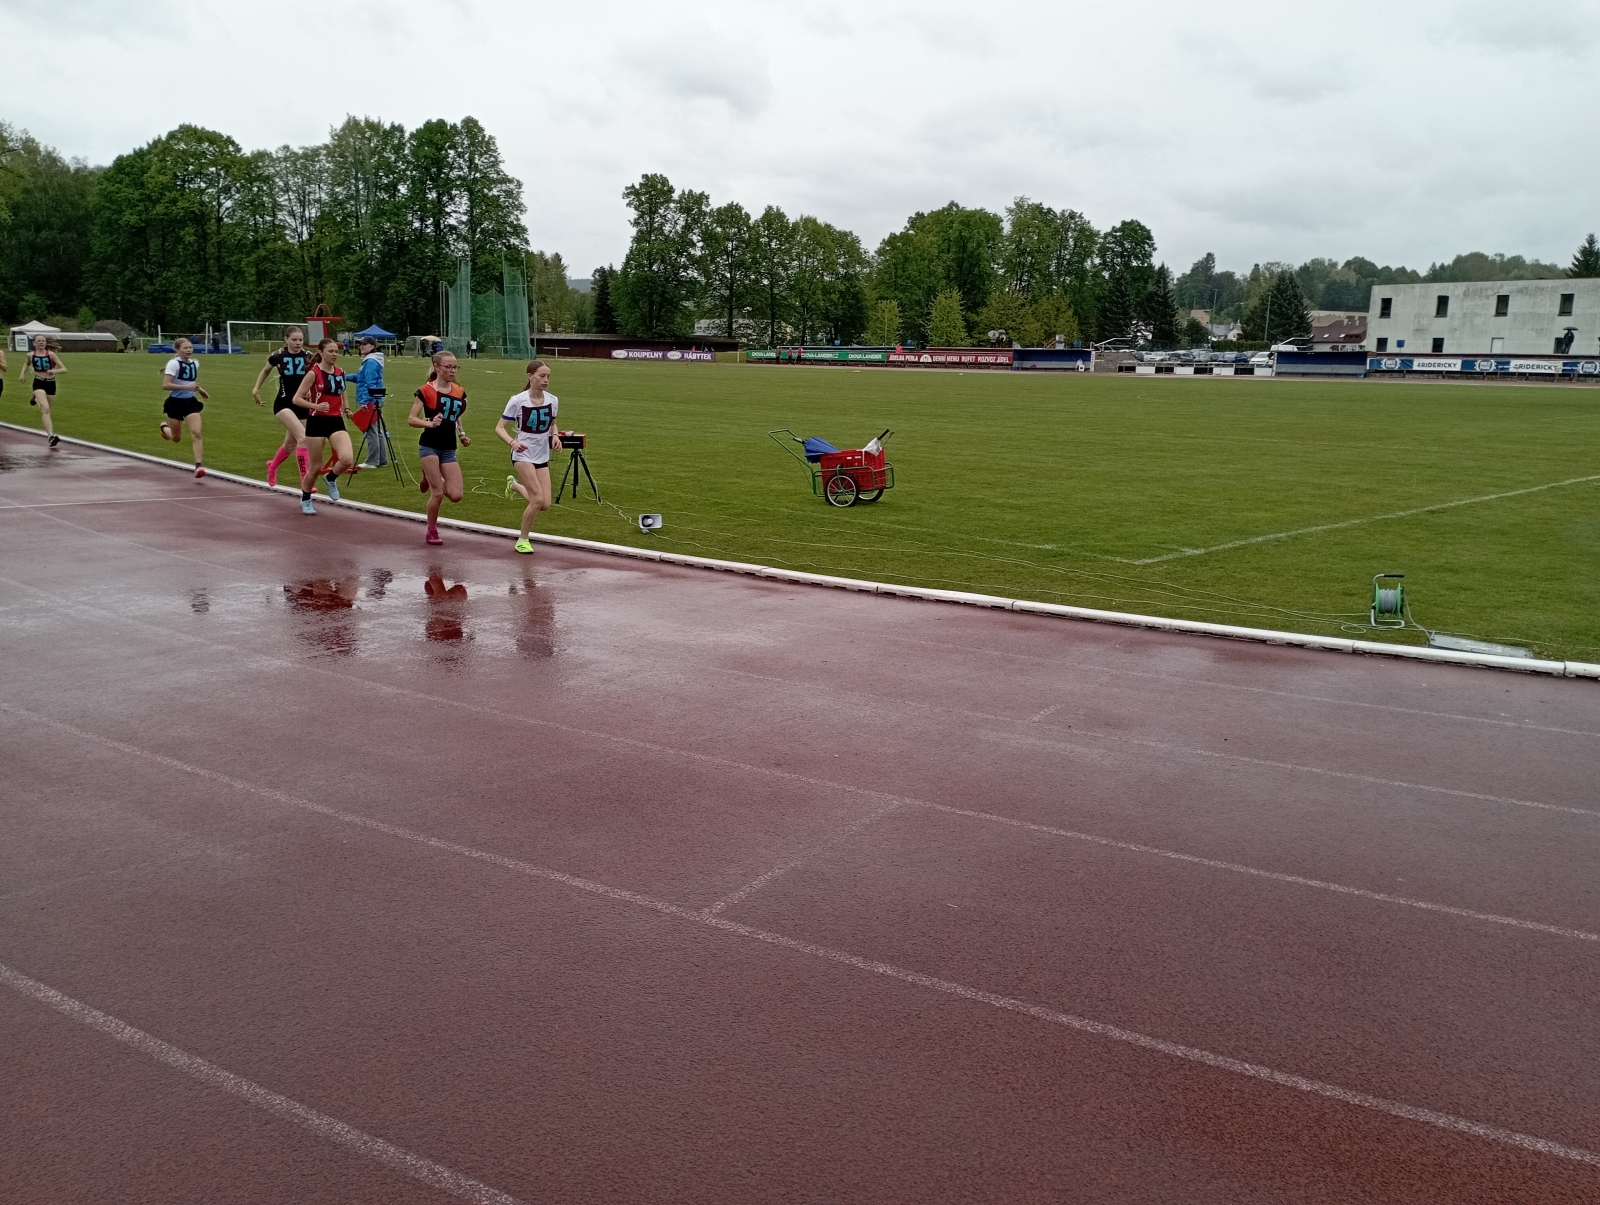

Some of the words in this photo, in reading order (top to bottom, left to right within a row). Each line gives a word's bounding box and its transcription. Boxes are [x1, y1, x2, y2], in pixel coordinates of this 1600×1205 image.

[628, 351, 663, 359] KOUPELNY
[684, 351, 712, 360] NÁBYTEK
[996, 355, 1010, 363] JÍDEL
[34, 357, 51, 371] 36
[182, 363, 196, 379] 31
[283, 357, 305, 375] 32
[327, 375, 345, 395] 13
[440, 396, 463, 422] 35
[526, 407, 551, 431] 45
